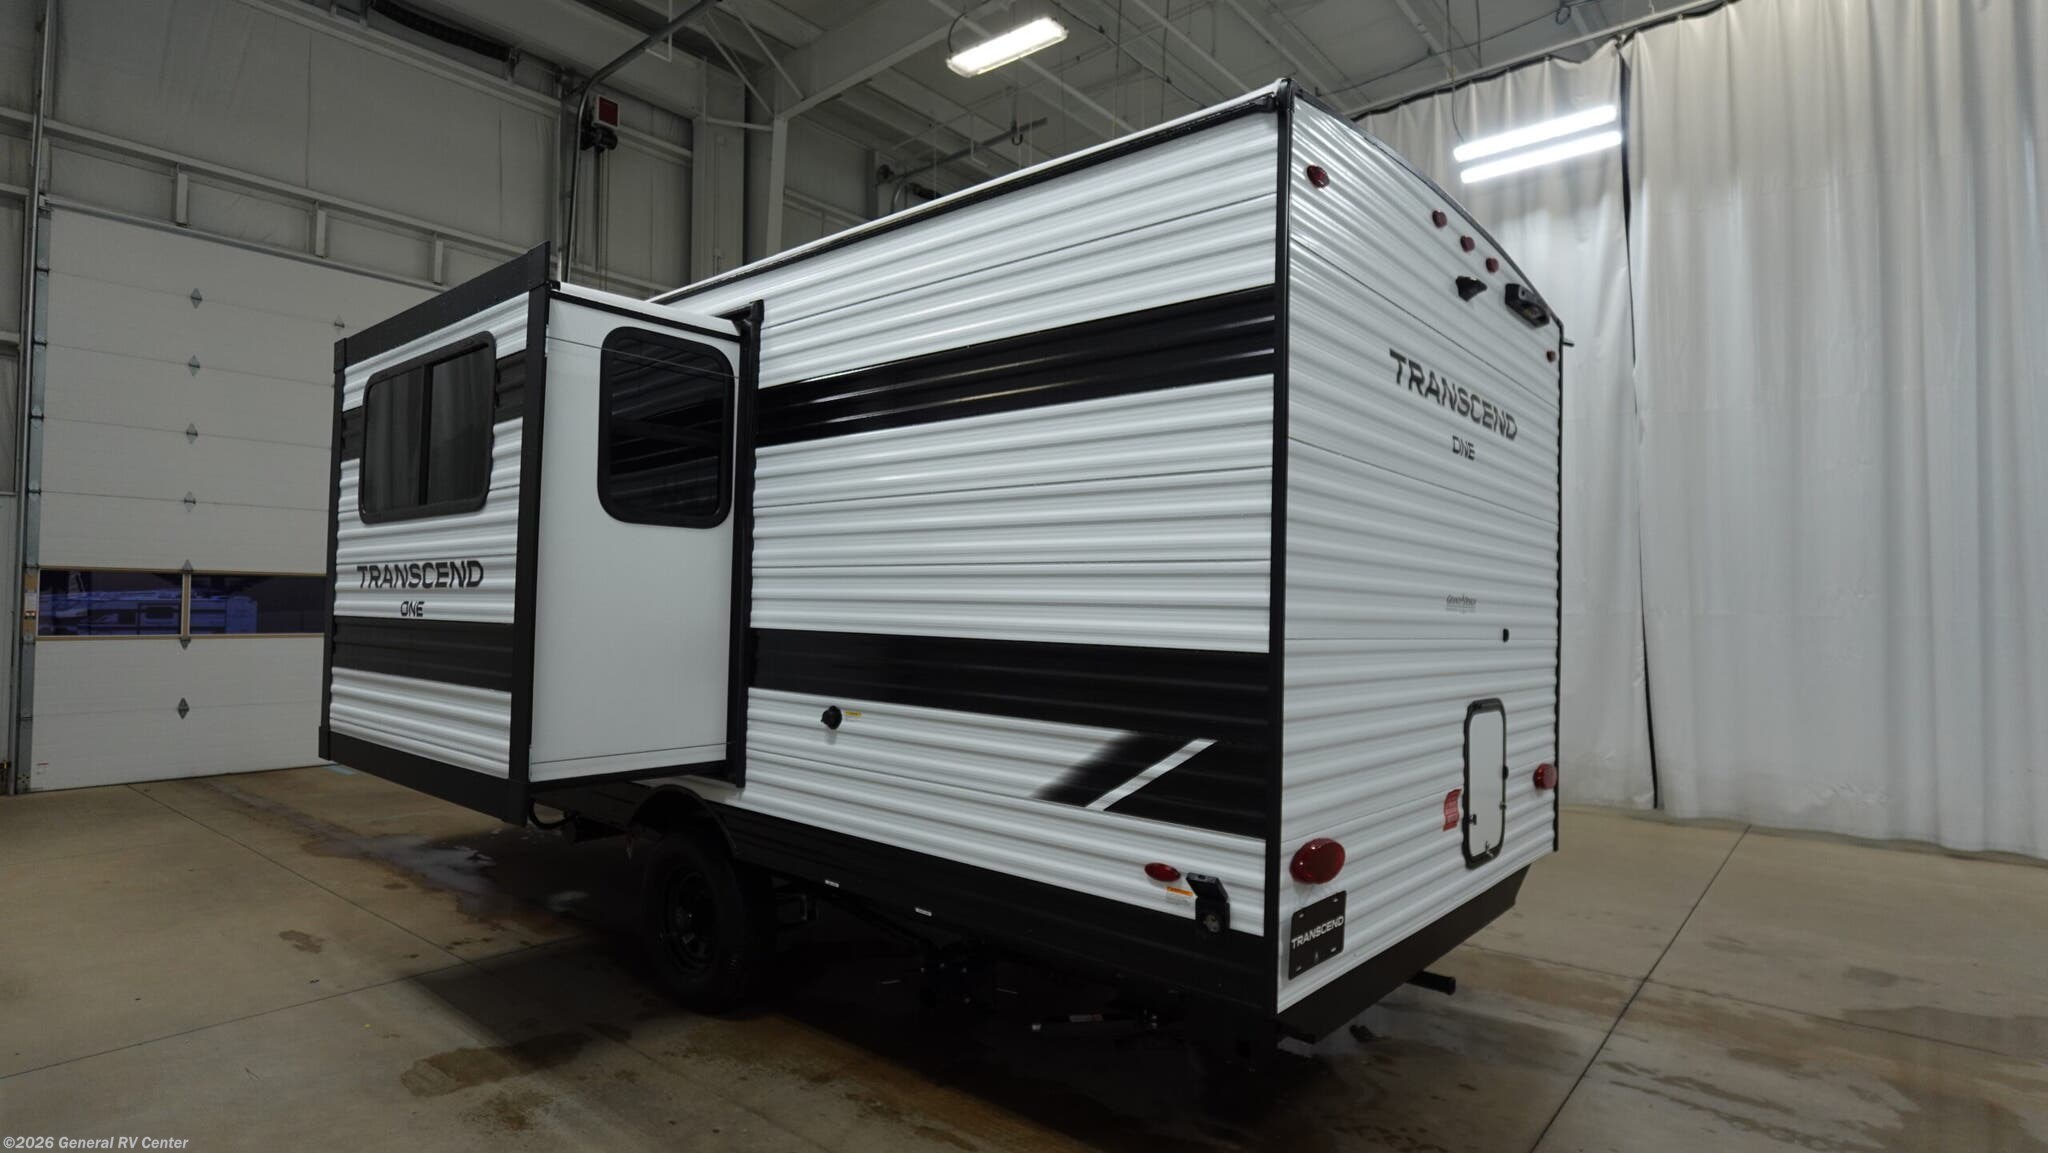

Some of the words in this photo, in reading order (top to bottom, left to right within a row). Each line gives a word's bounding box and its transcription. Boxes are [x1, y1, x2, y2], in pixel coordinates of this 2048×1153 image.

[1389, 348, 1518, 441] TRANSCEND
[1452, 435, 1476, 461] ONE
[356, 560, 484, 588] TRANSCEND
[400, 600, 424, 617] ONE
[1291, 915, 1344, 949] TRANSCEND
